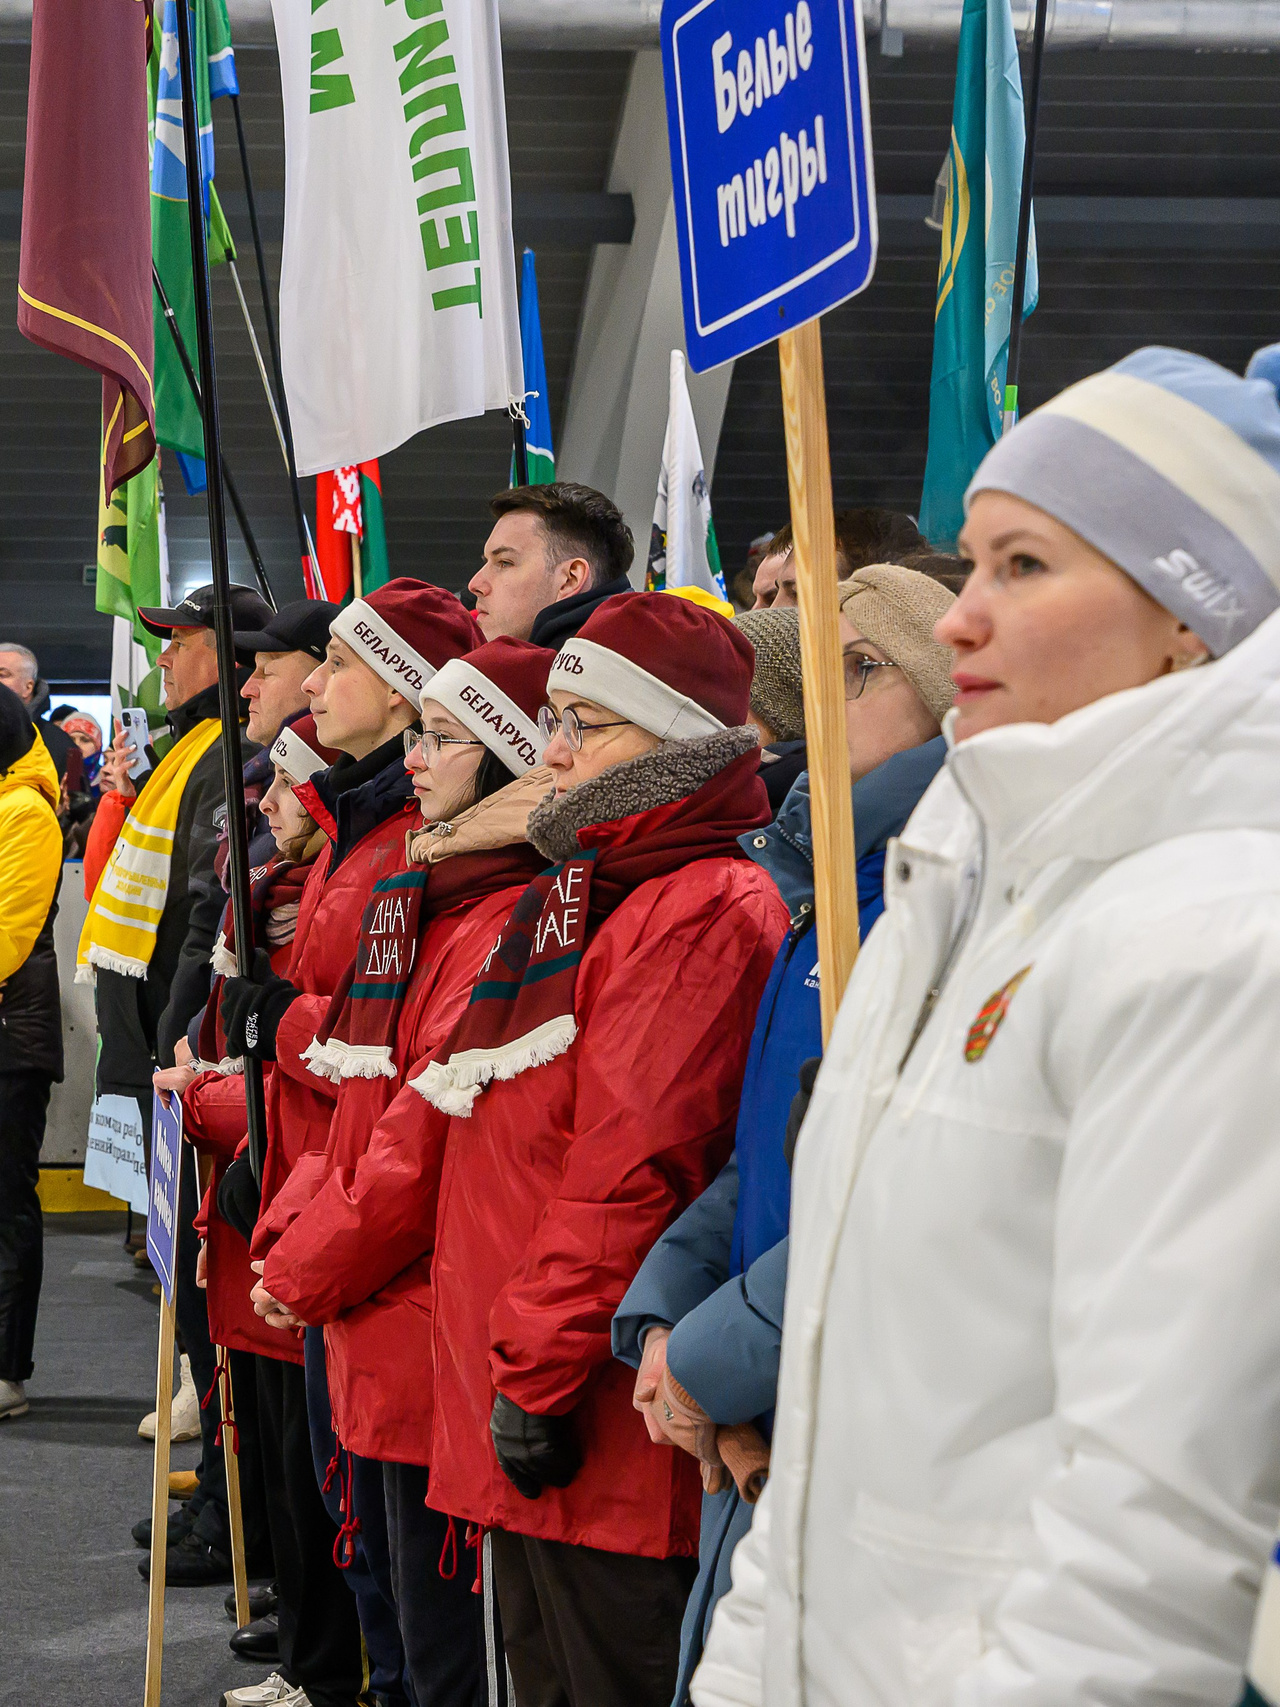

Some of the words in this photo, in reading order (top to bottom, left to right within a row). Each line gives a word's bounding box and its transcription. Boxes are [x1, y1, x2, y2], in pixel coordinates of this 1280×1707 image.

[711, 0, 813, 134] Белые
[717, 114, 827, 247] тигры
[353, 621, 423, 691] БЕЛАРУСЬ
[459, 685, 537, 766] БЕЛАРУСЬ
